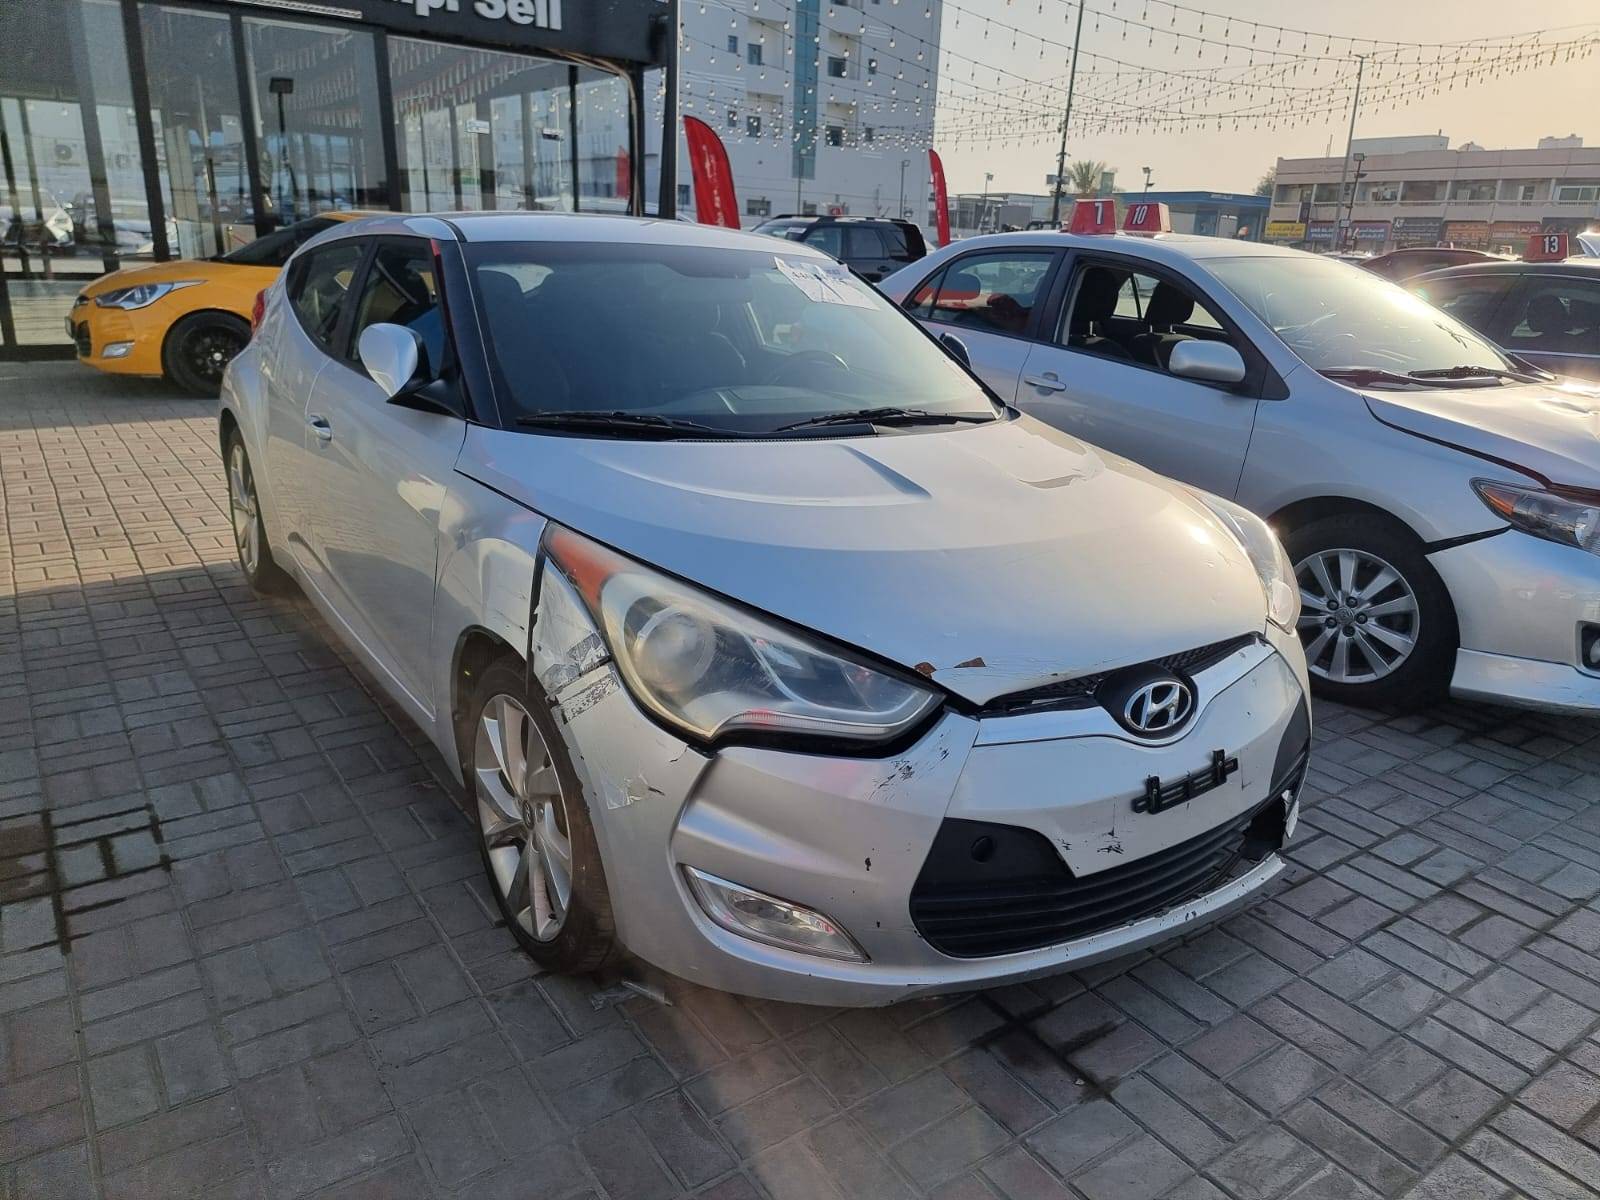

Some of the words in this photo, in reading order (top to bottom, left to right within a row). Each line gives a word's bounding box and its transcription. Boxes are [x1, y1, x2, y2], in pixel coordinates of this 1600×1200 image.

[1094, 202, 1103, 224] 7
[1132, 205, 1149, 225] 10
[1543, 235, 1559, 254] 13
